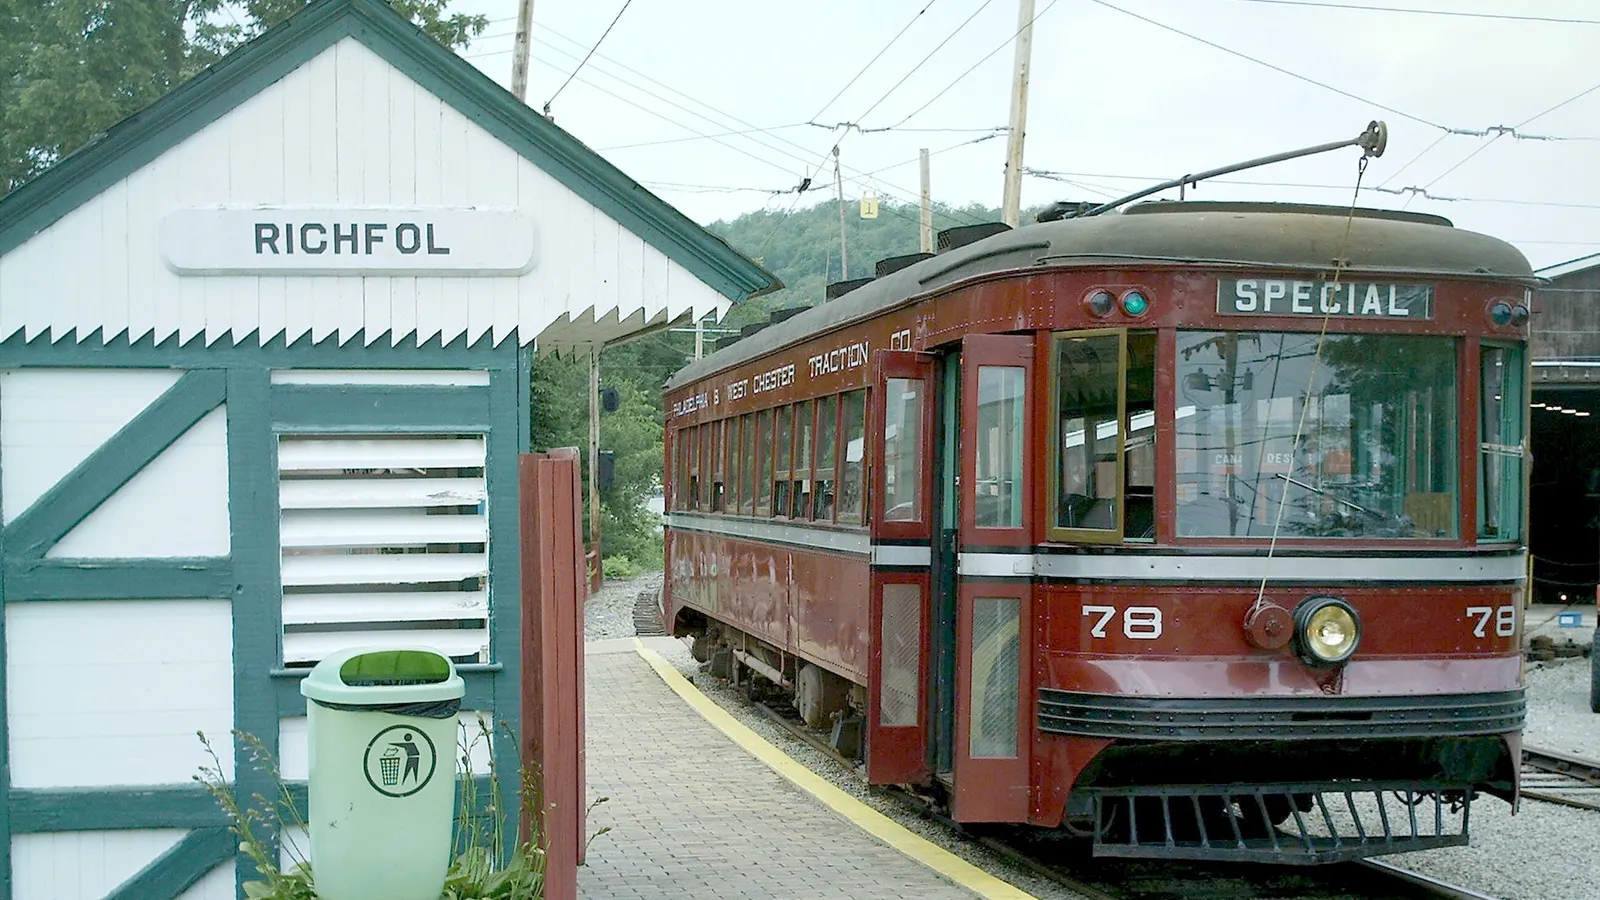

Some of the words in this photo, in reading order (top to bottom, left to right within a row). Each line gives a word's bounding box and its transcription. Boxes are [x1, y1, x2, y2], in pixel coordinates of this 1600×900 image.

[254, 222, 450, 255] RICHFOL
[1235, 278, 1409, 316] SPECIAL
[727, 379, 748, 401] WEST
[753, 364, 795, 393] CHESTER
[808, 341, 869, 378] TRACTION
[1082, 605, 1163, 639] 78
[1466, 605, 1516, 638] 78
